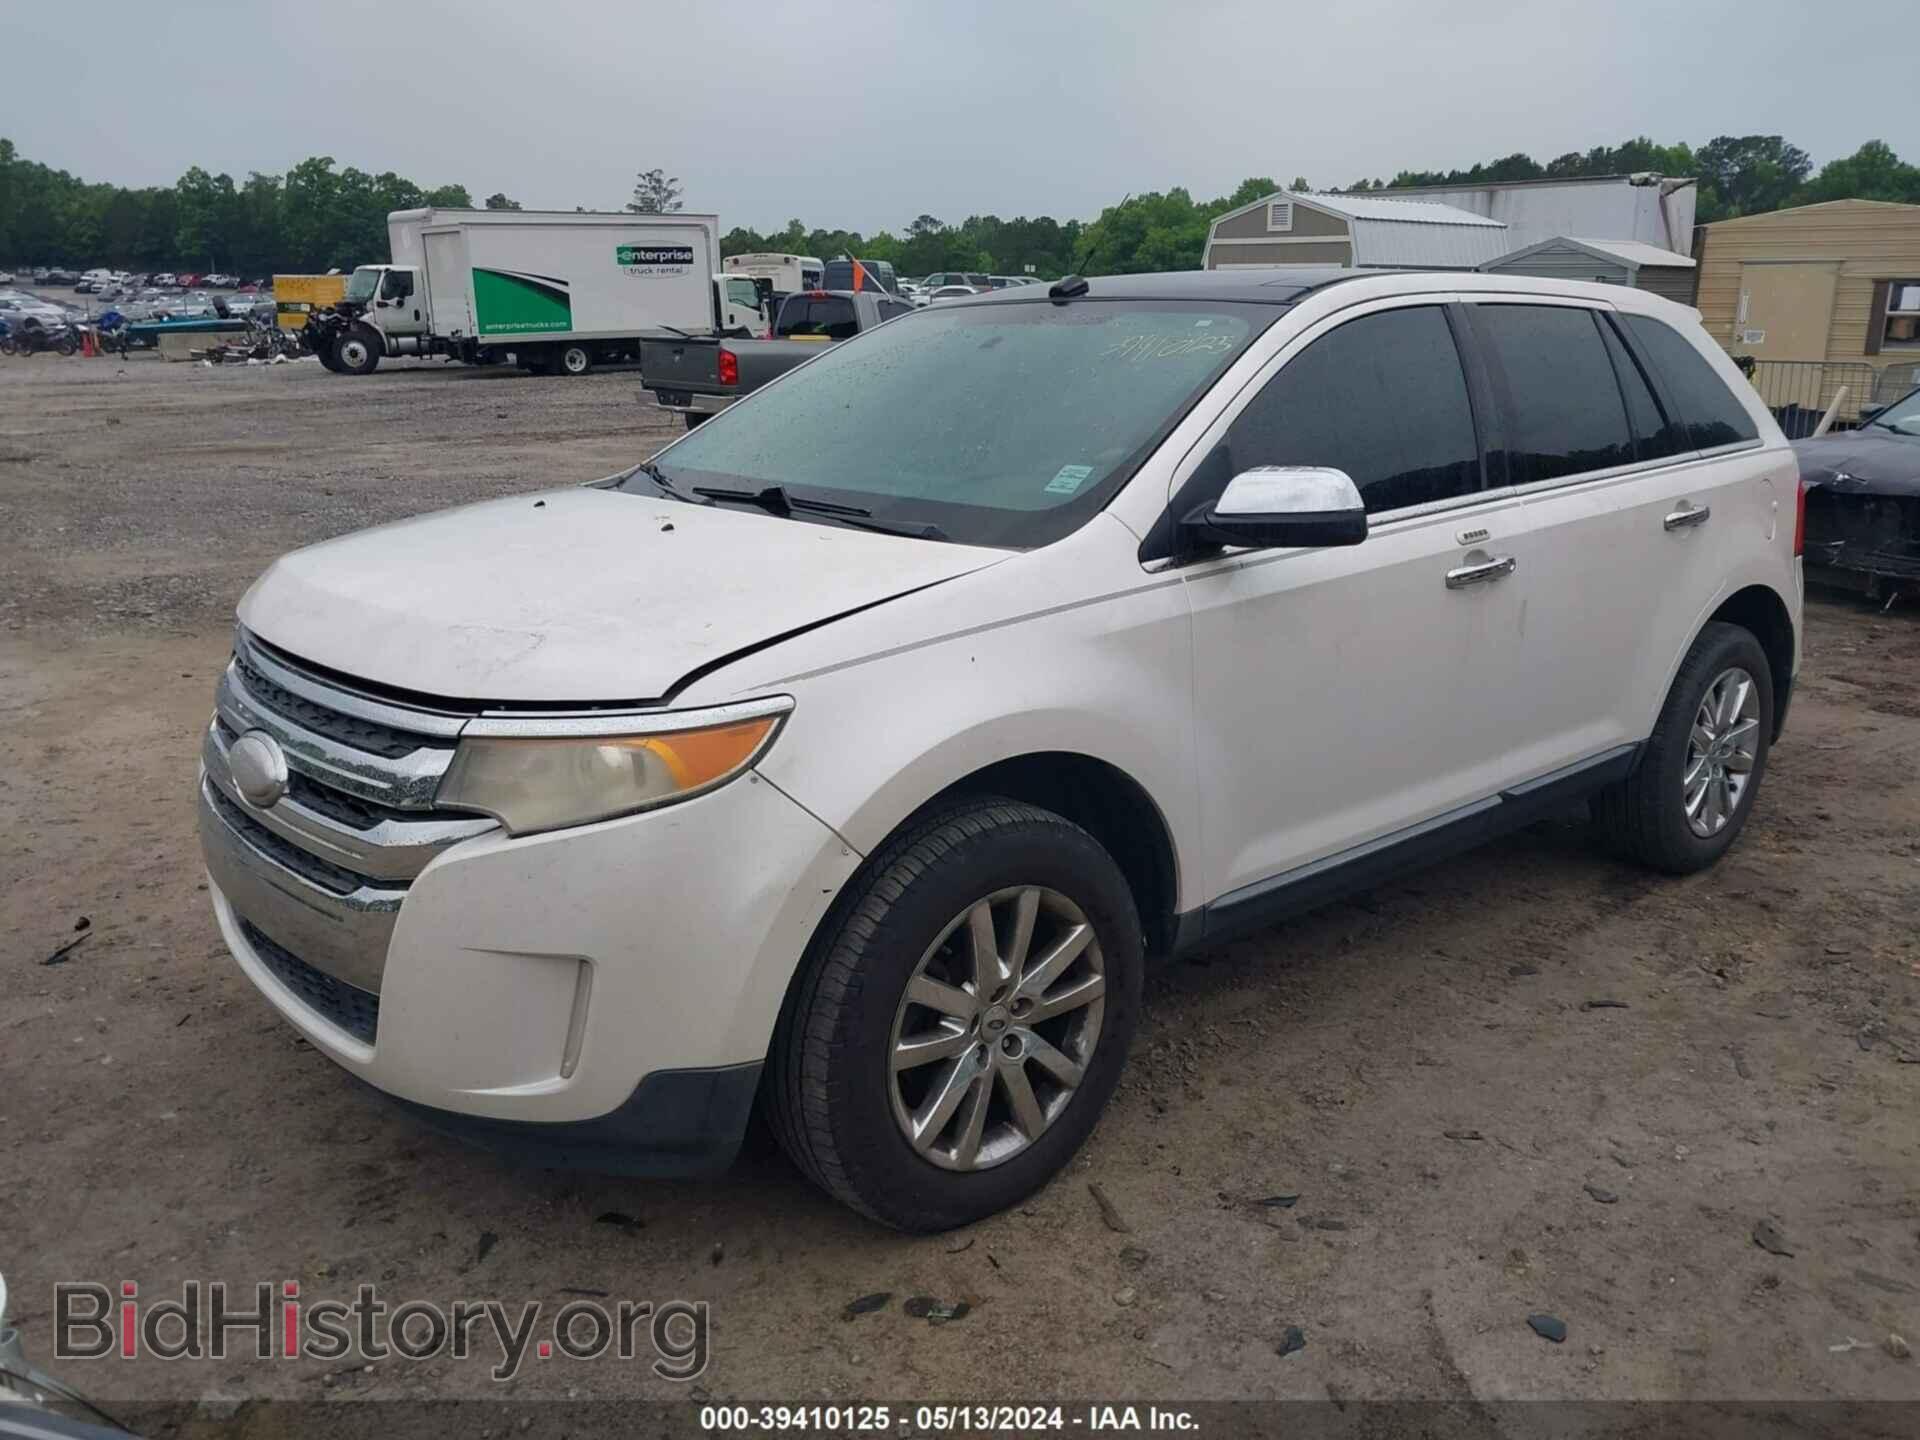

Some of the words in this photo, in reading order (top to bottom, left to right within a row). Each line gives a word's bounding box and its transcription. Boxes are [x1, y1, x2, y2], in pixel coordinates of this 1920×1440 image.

[618, 249, 692, 263] enterprise
[631, 266, 653, 274] truck
[656, 266, 683, 274] rental
